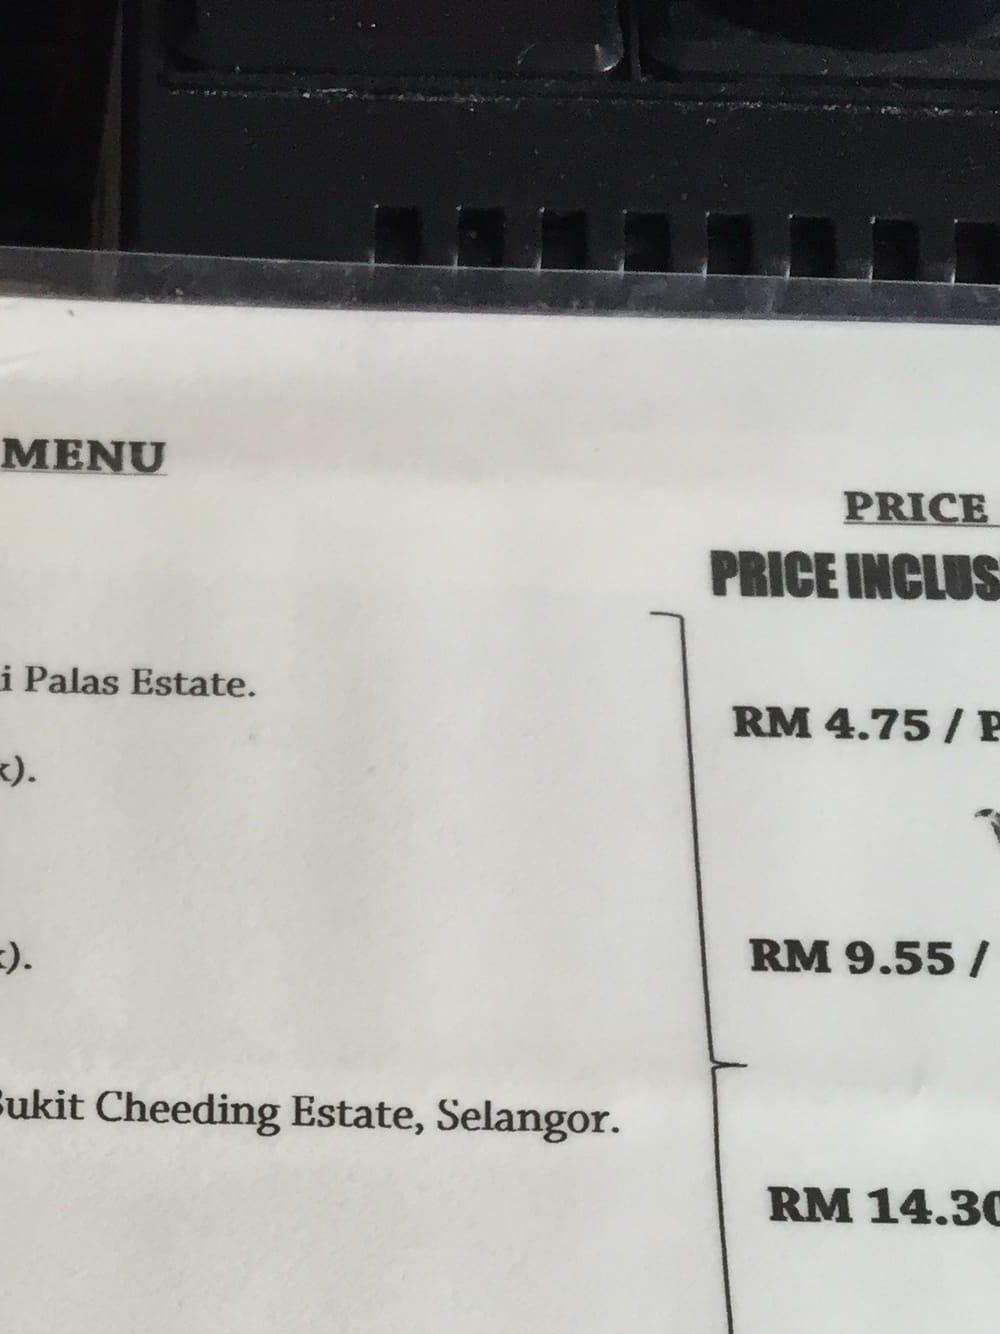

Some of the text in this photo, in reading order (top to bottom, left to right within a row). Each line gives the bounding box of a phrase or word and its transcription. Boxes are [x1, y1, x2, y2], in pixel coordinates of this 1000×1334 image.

[0, 437, 167, 476] MENU
[843, 490, 989, 523] PRICE
[709, 549, 840, 600] PRICE
[24, 665, 120, 696] Palas
[130, 668, 256, 698] Estate.
[731, 705, 931, 742] RM 4.75
[748, 938, 956, 976] RM 9.55
[95, 1090, 281, 1137] Cheeding
[291, 1095, 425, 1136] Estate,
[436, 1098, 620, 1144] Selangor.
[766, 1185, 1000, 1228] RM 14.30
